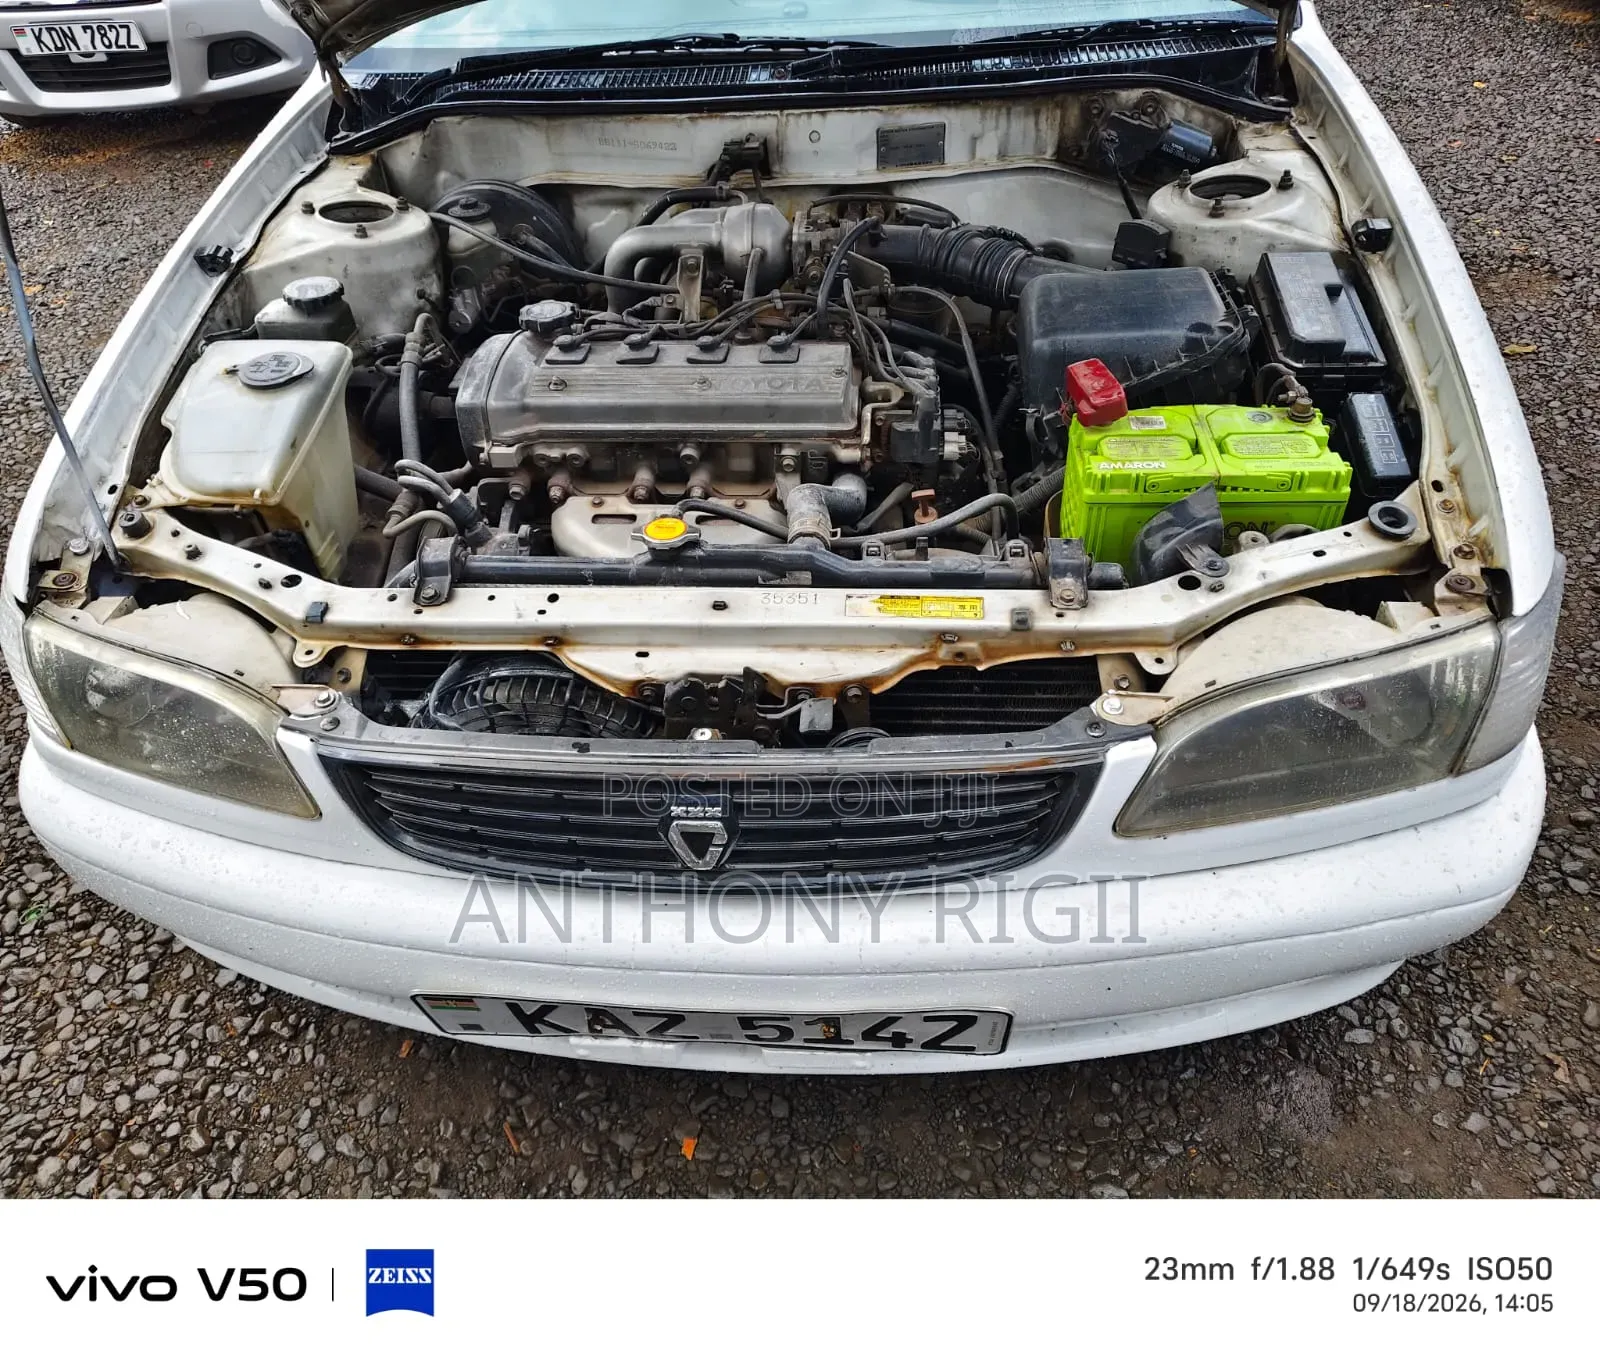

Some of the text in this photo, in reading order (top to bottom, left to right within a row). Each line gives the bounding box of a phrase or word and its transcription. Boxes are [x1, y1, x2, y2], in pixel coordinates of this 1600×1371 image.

[31, 24, 140, 53] KDN 782Z
[713, 377, 826, 393] TOYOTA
[1099, 461, 1167, 470] AMARON
[760, 592, 818, 605] 35351
[505, 1001, 700, 1040] KAZ
[736, 1014, 979, 1052] 514Z
